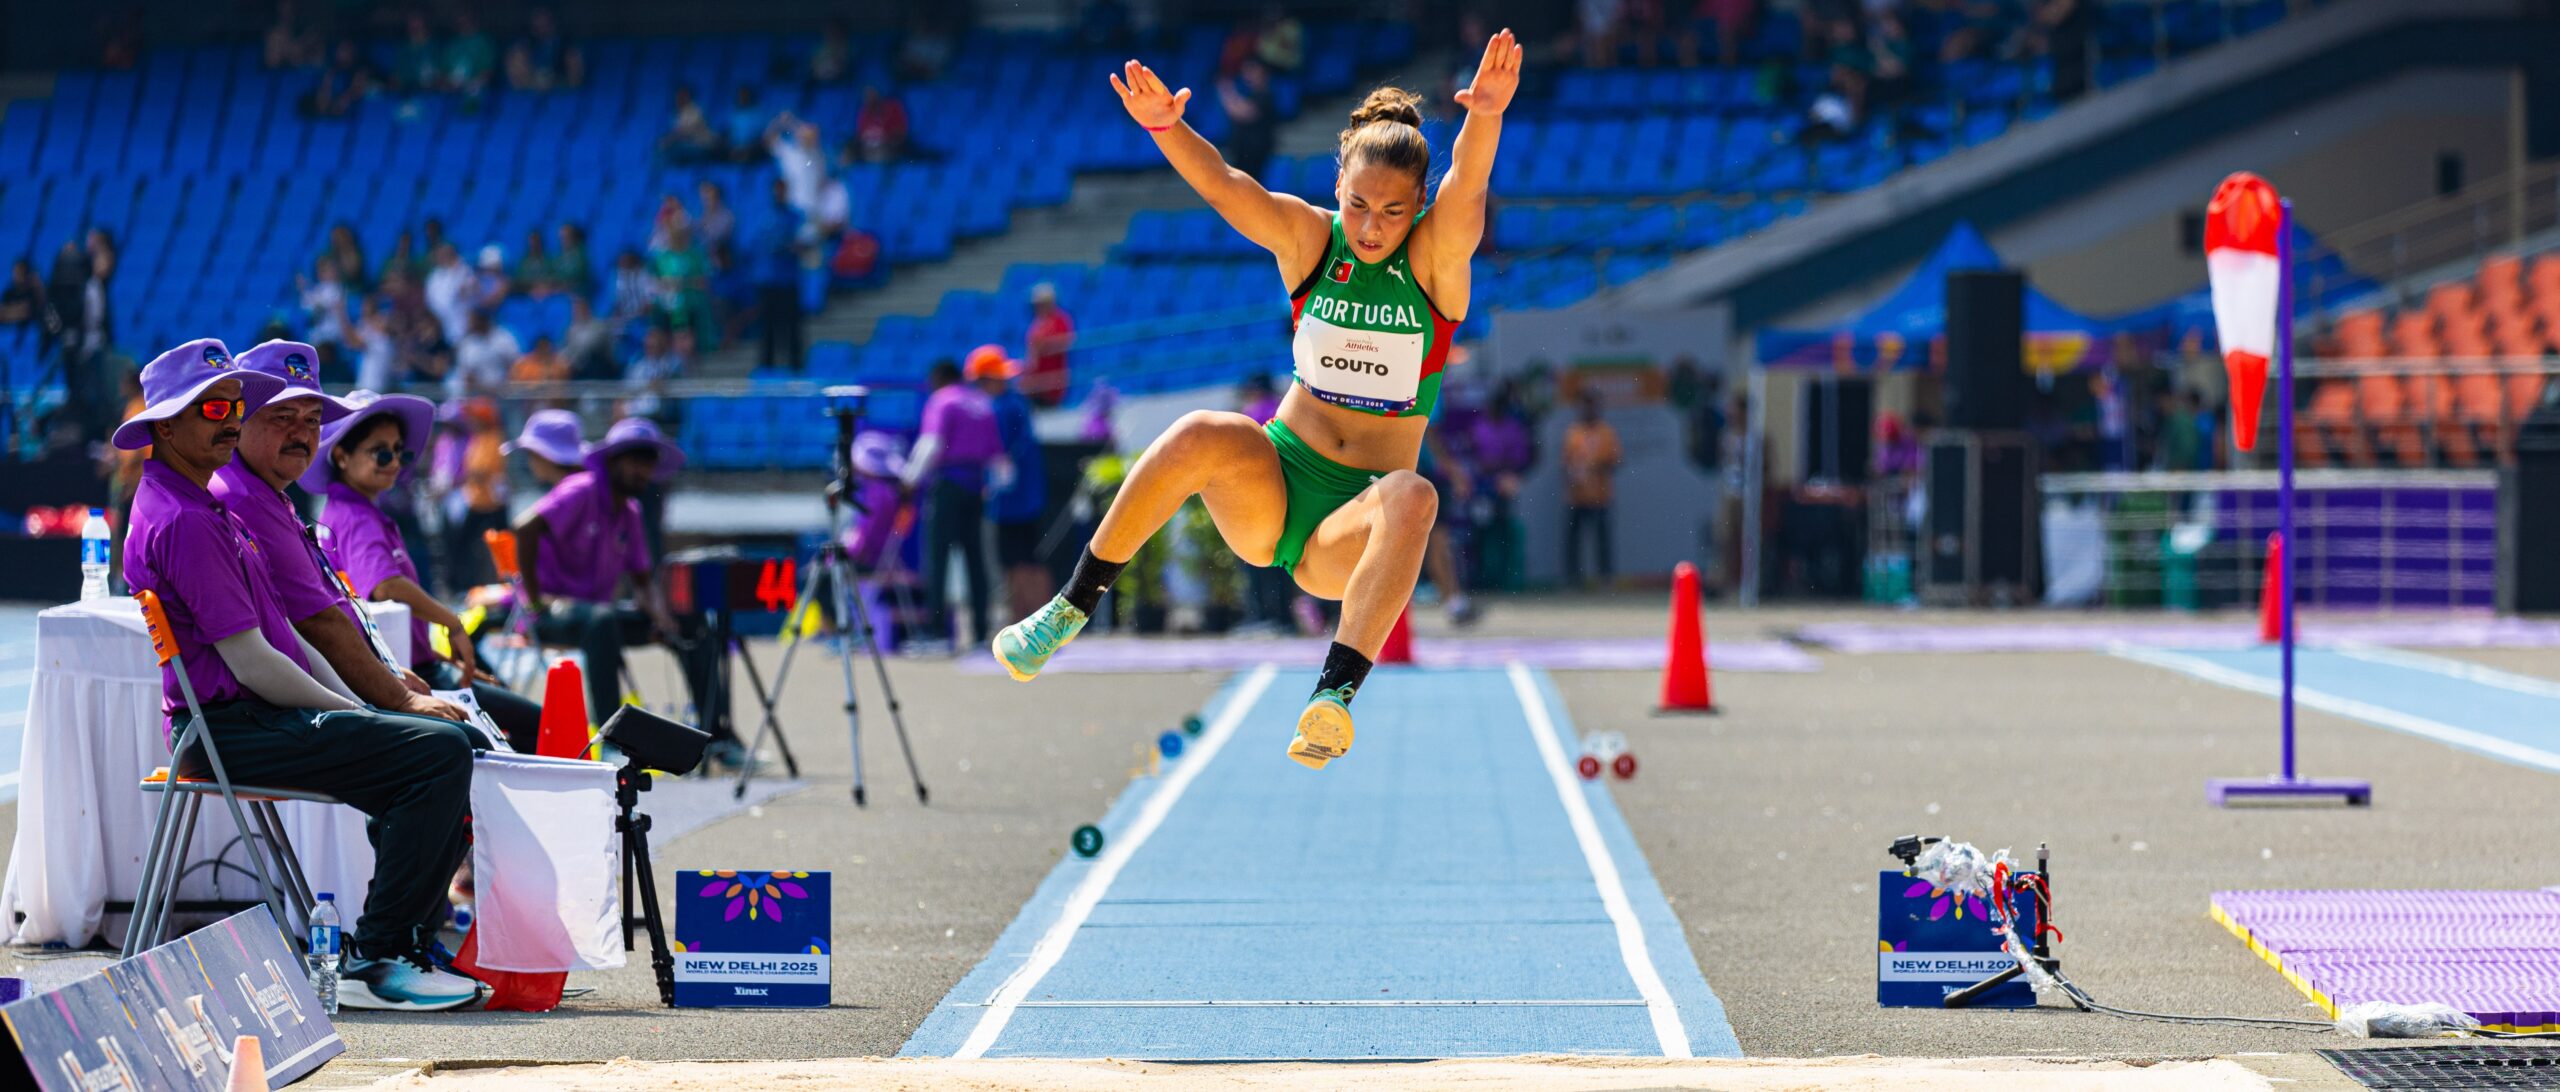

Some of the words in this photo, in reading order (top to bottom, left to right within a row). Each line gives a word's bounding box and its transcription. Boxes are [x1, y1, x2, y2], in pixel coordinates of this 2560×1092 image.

[1311, 295, 1422, 328] PORTUGAL
[1344, 342, 1379, 353] Athletics
[1320, 355, 1389, 376] COUTO
[1321, 393, 1338, 402] NEW
[1340, 396, 1364, 405] DELHI
[685, 961, 725, 970] NEW
[728, 961, 777, 971] DELHI
[780, 961, 818, 972] 2025
[1892, 960, 1931, 970] NEW
[1935, 960, 1983, 970] DELHI
[1988, 960, 2016, 970] 202
